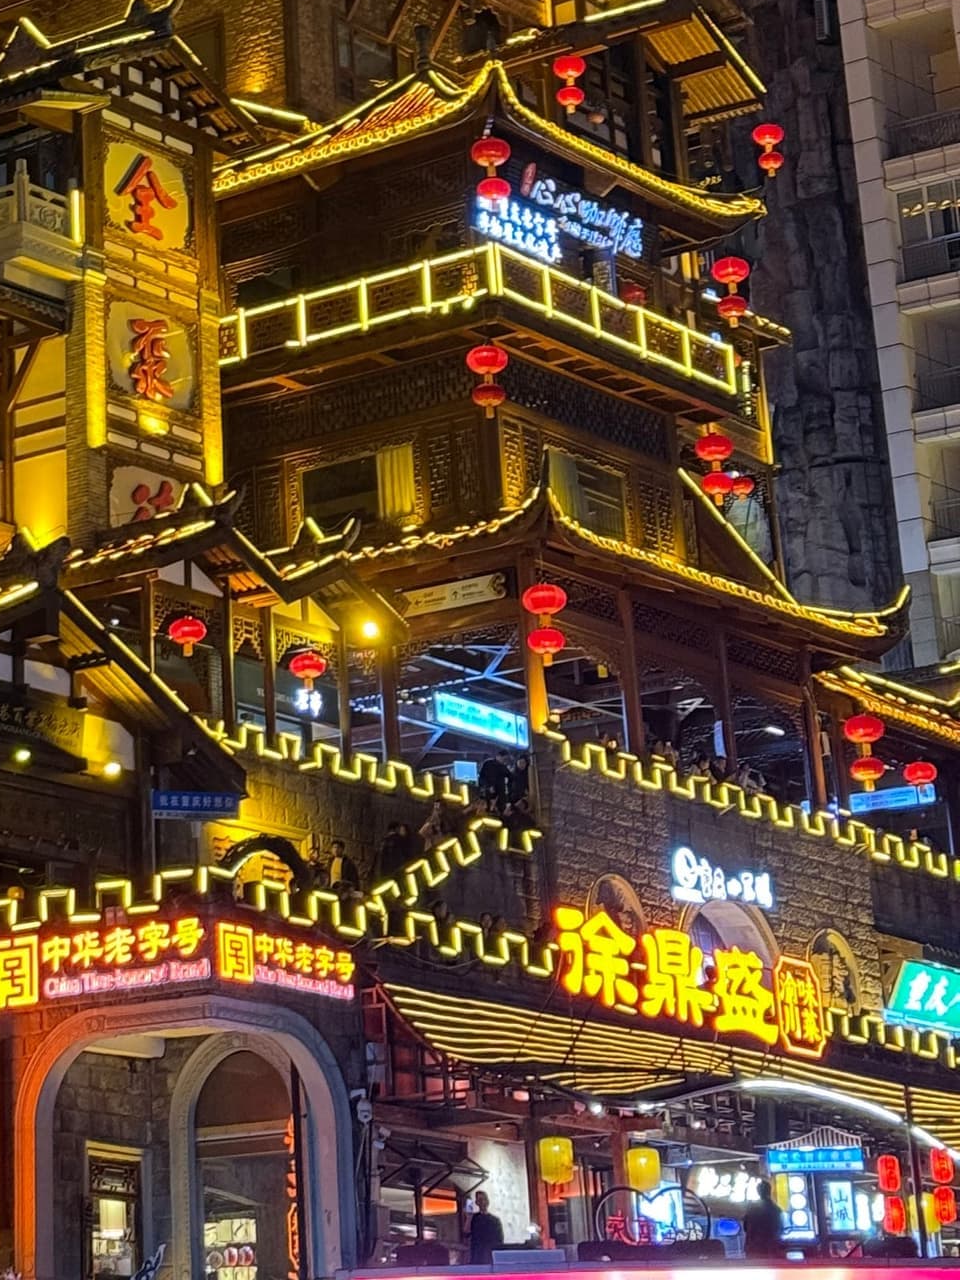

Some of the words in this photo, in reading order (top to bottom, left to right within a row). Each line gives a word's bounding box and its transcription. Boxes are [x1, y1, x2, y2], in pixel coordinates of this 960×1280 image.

[42, 916, 205, 973] 中华老字号
[168, 958, 211, 981] Brand
[254, 932, 356, 983] 中华老字号
[555, 907, 779, 1045] 徐鼎盛
[904, 970, 960, 1016] 重庆
